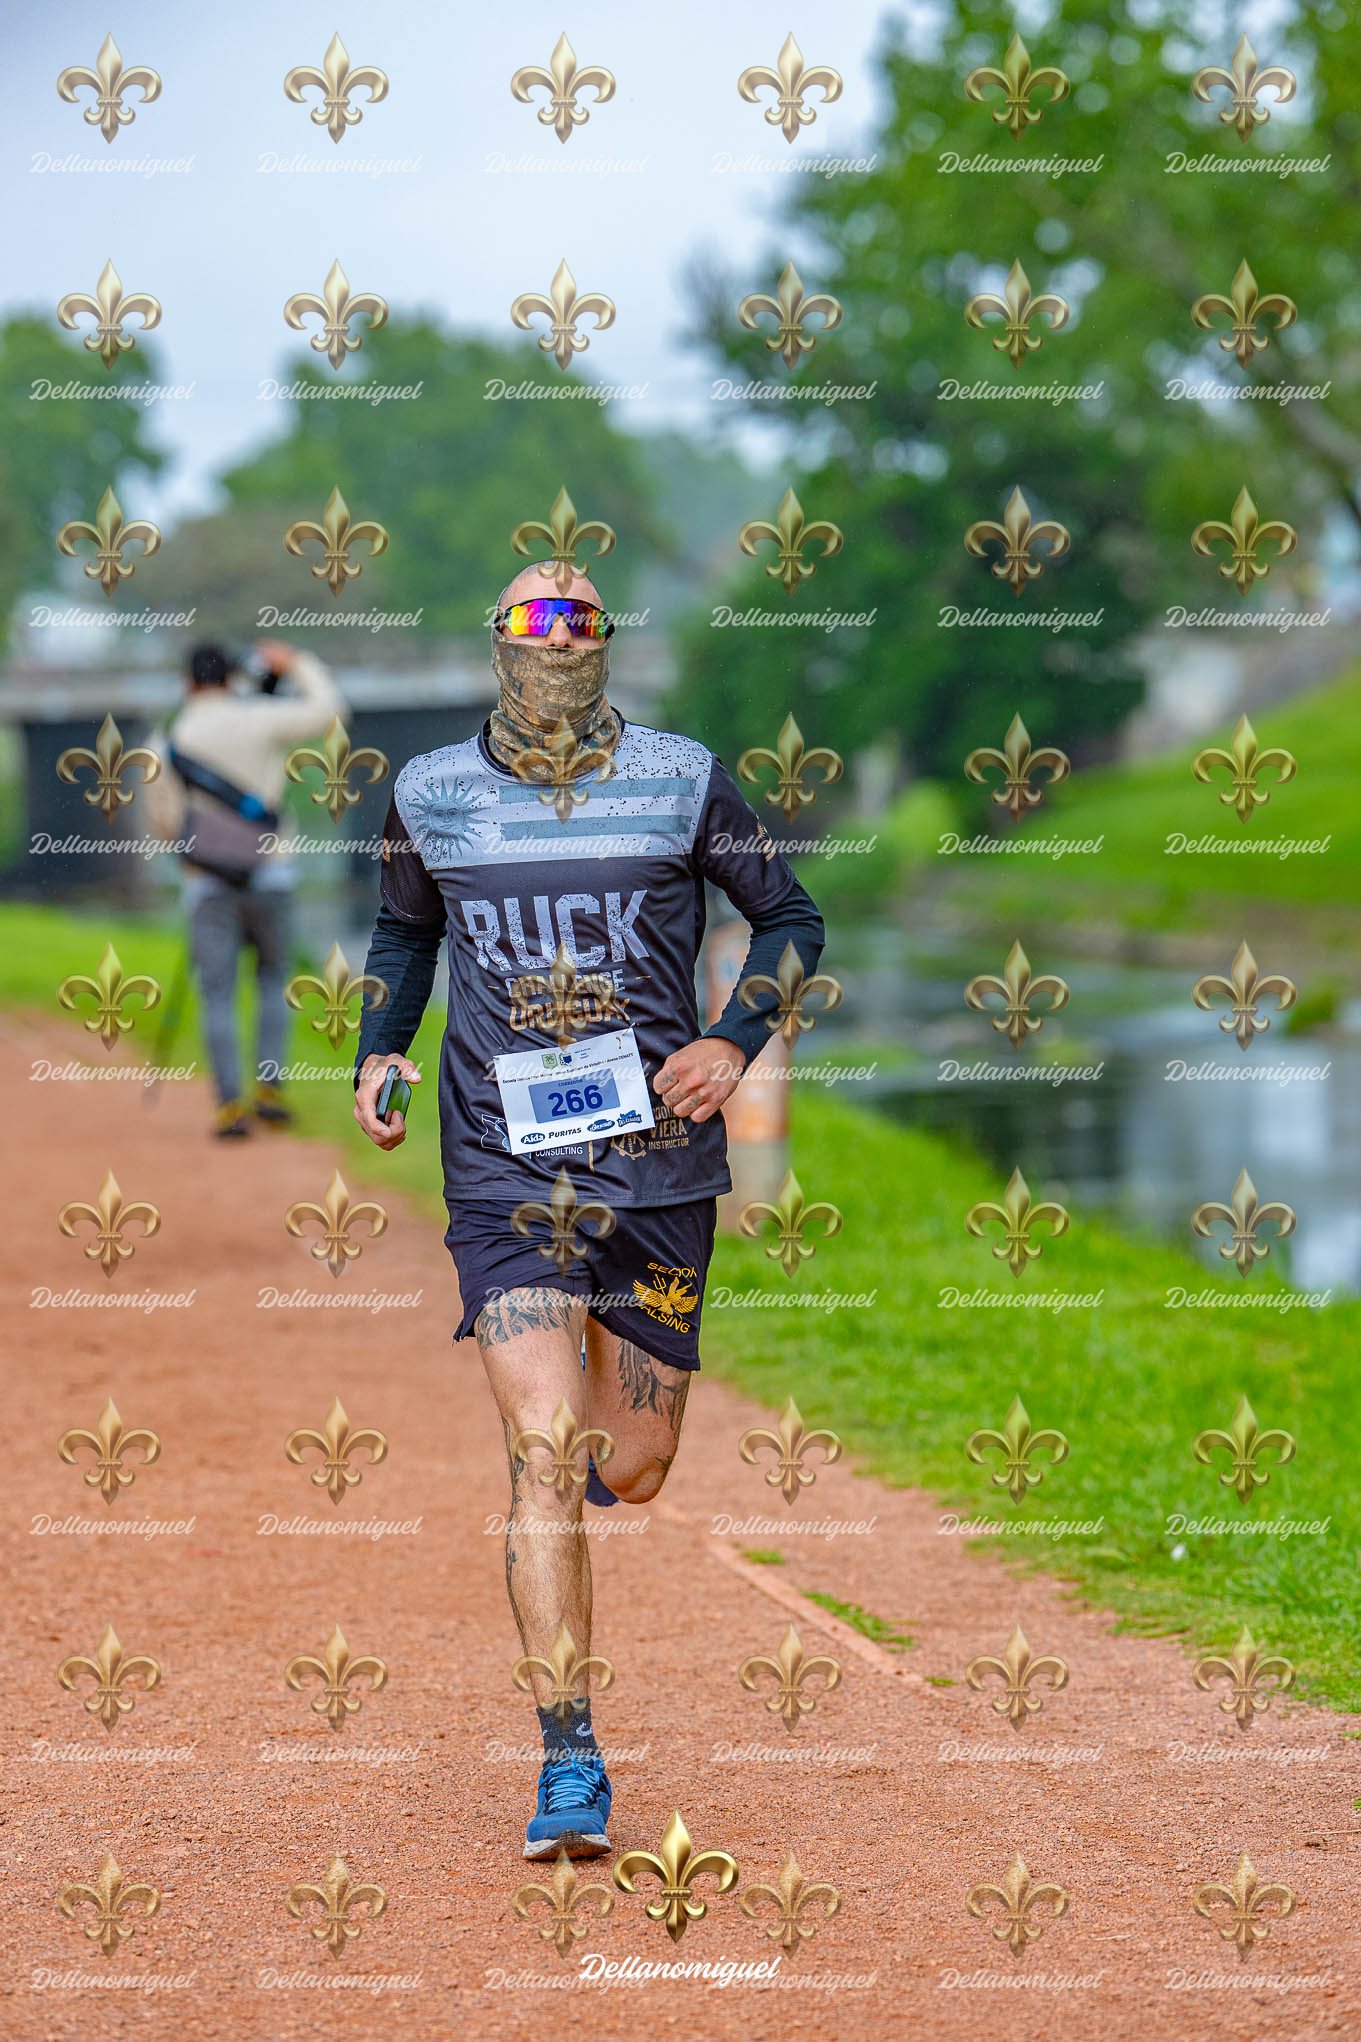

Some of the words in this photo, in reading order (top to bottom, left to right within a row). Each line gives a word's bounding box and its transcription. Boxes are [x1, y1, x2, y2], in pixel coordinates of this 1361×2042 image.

[461, 889, 649, 972] RUCK
[504, 968, 626, 998] CHALLENGE
[509, 998, 631, 1031] URUGUAY
[547, 1084, 603, 1117] 266
[548, 1127, 582, 1139] PURITAS
[650, 1119, 687, 1138] VIERA
[535, 1146, 583, 1157] CONSULTING
[648, 1137, 689, 1150] INSTRUCTOR
